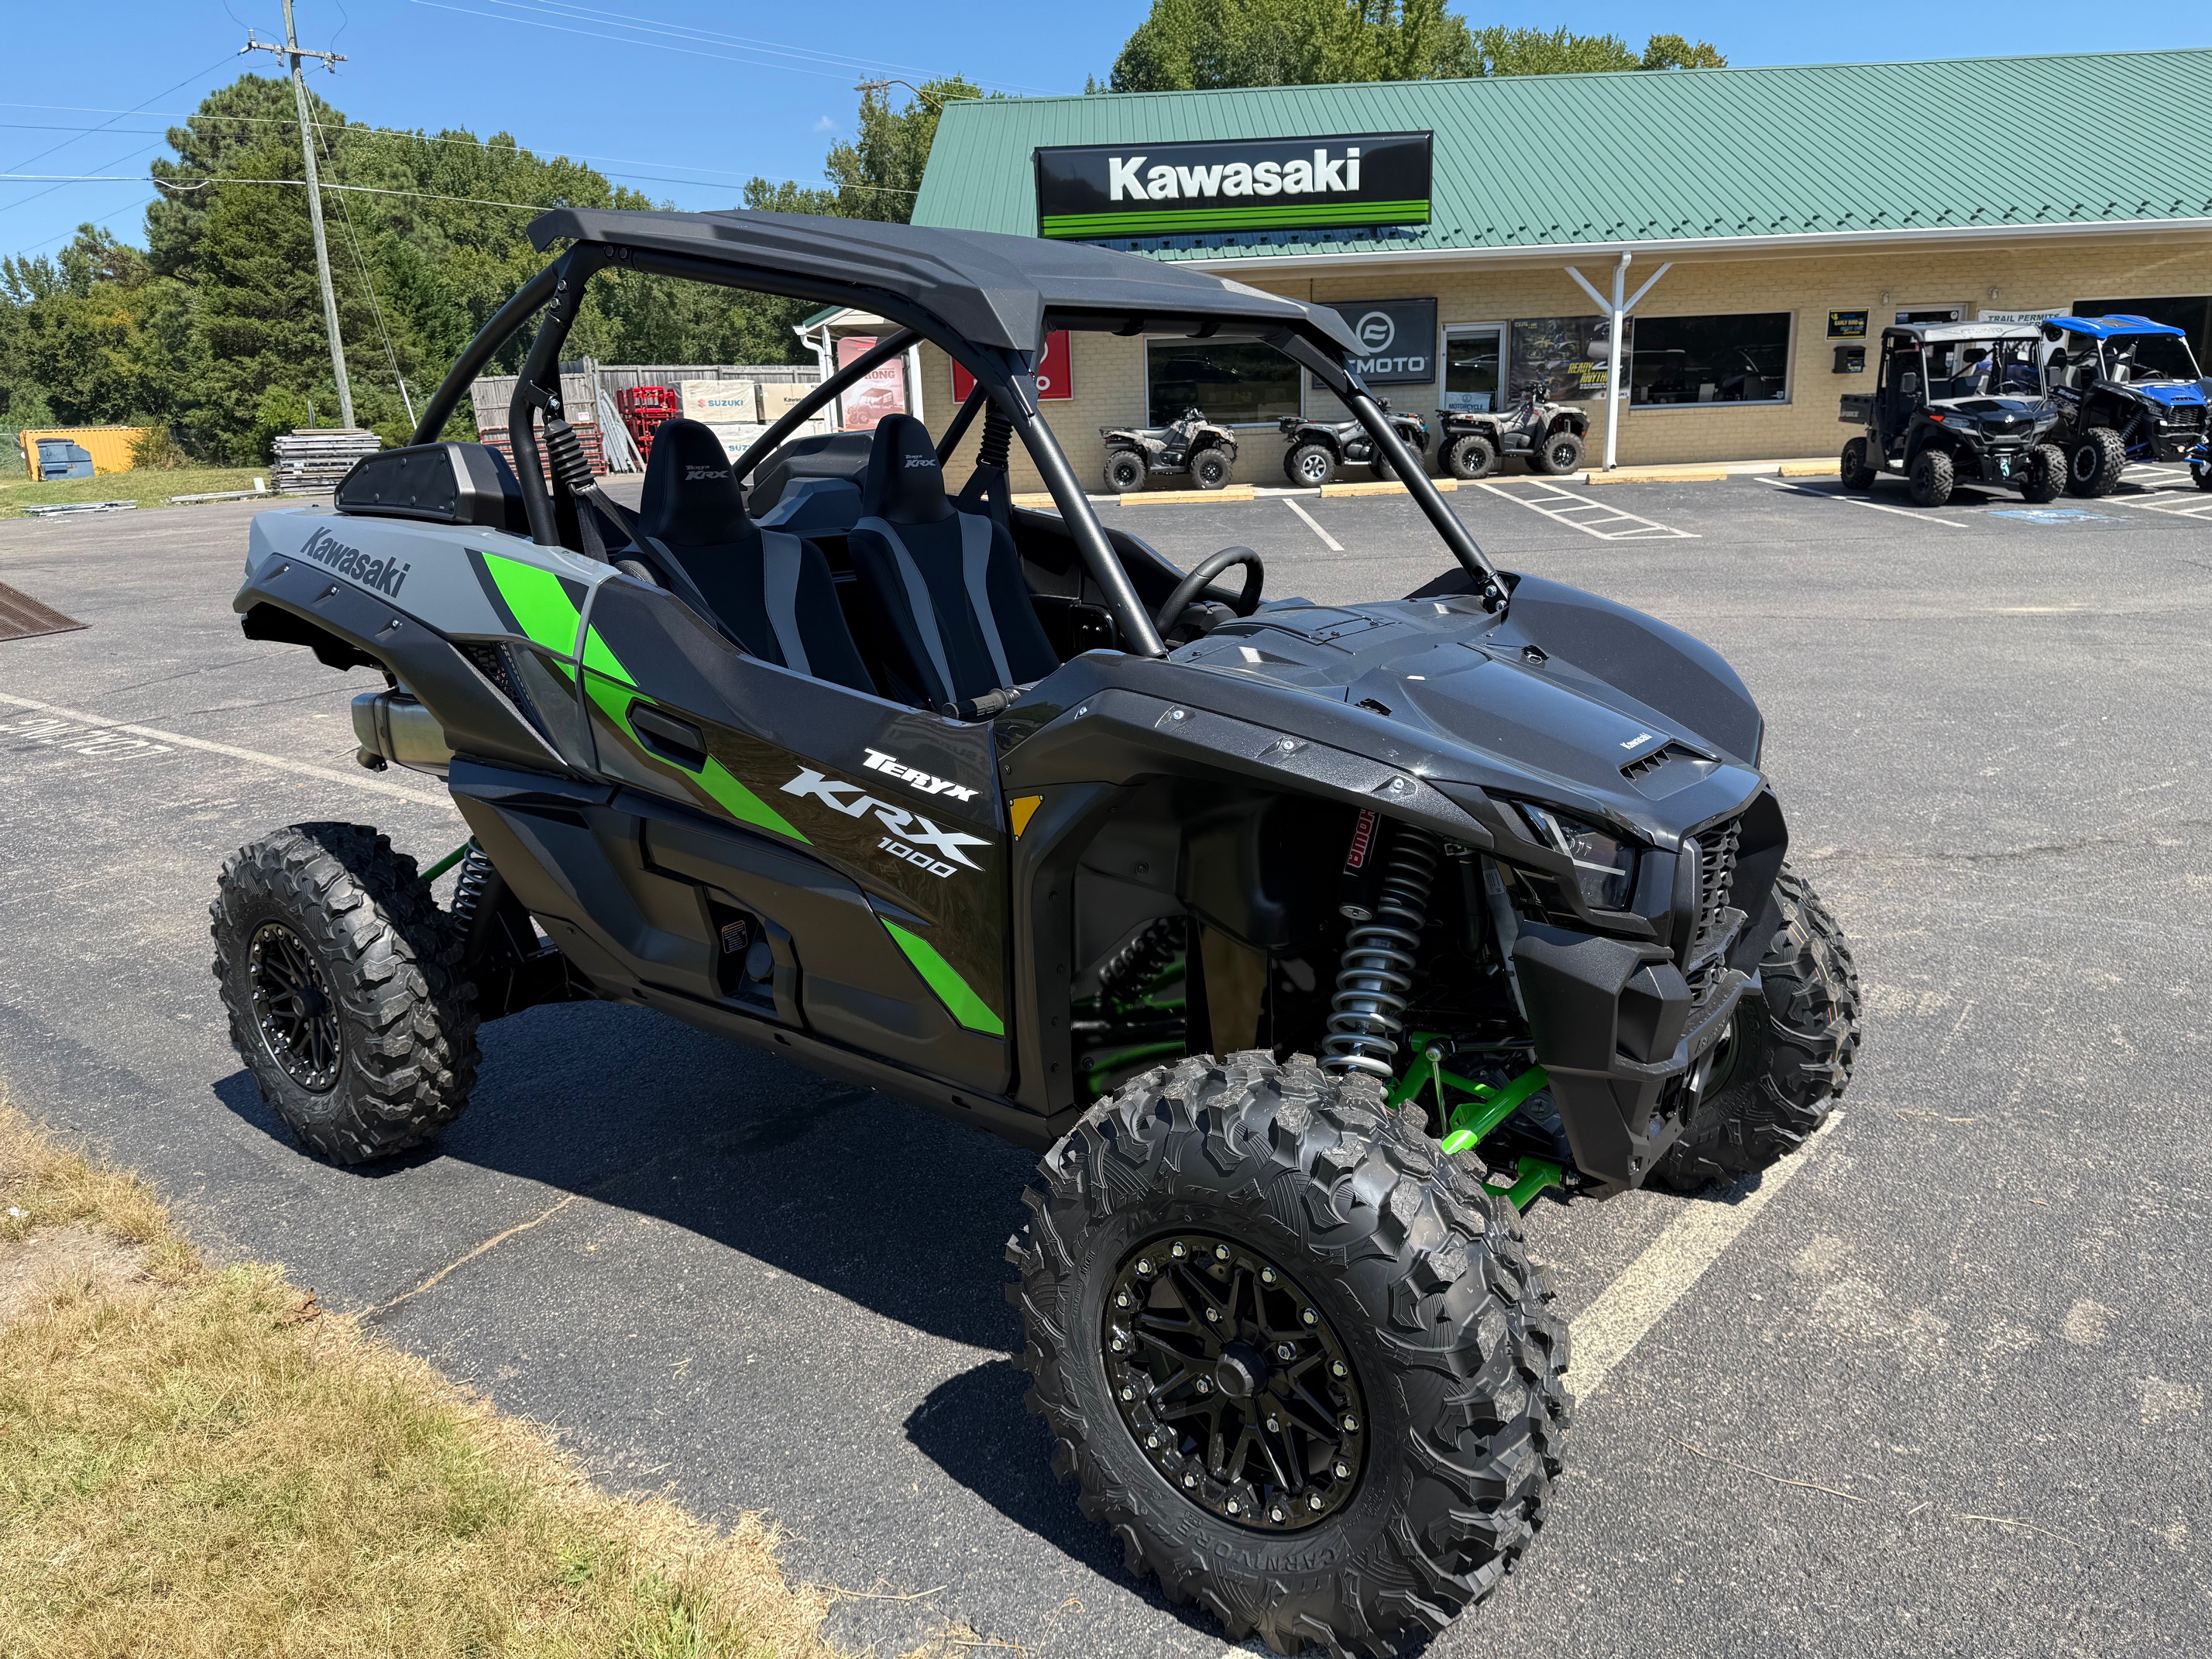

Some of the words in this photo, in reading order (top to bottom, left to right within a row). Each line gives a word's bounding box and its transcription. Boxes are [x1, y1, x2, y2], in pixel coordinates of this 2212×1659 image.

[1108, 147, 1360, 201] Kawasaki
[2018, 313, 2060, 321] PERMITS
[1348, 356, 1425, 374] MOTO
[1568, 362, 1594, 374] READY
[864, 370, 895, 380] ONG
[1580, 372, 1608, 383] ANYTHI
[905, 459, 936, 469] KRX
[685, 470, 730, 481] KRX
[300, 526, 411, 599] Kawasaki
[1620, 732, 1653, 750] Kawasaki
[779, 764, 995, 872] KRX
[1347, 808, 1376, 868] HOWA
[877, 836, 958, 878] 1000
[1175, 1520, 1336, 1575] CARNIVORE
